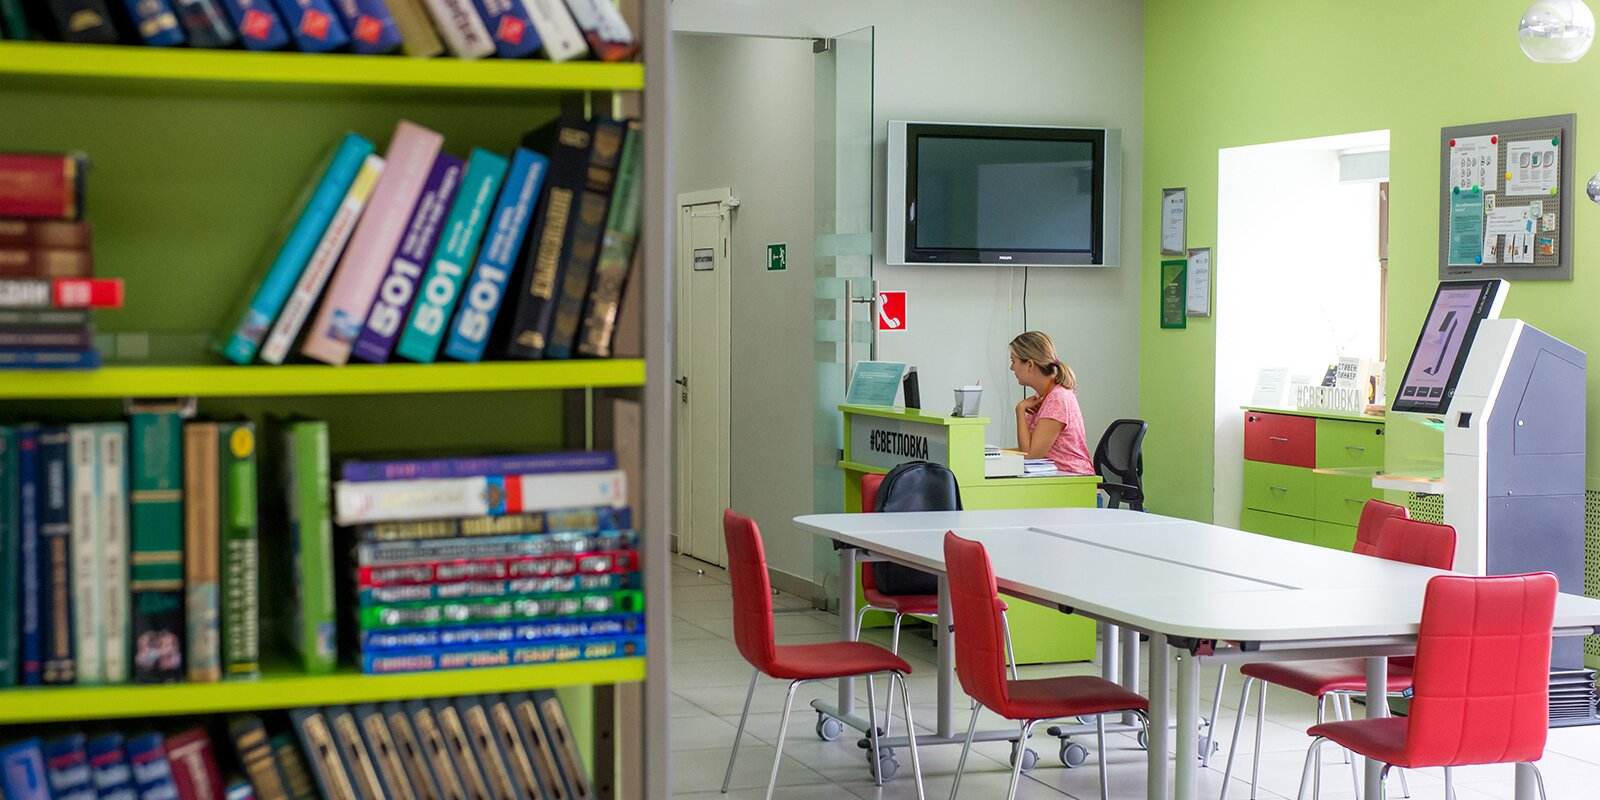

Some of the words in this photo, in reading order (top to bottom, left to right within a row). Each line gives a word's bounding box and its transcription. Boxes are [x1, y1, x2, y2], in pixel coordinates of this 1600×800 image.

[367, 257, 421, 338] 501
[413, 258, 462, 337] 501
[457, 264, 507, 342] 501
[870, 429, 929, 460] #СВЕТЛОВКА
